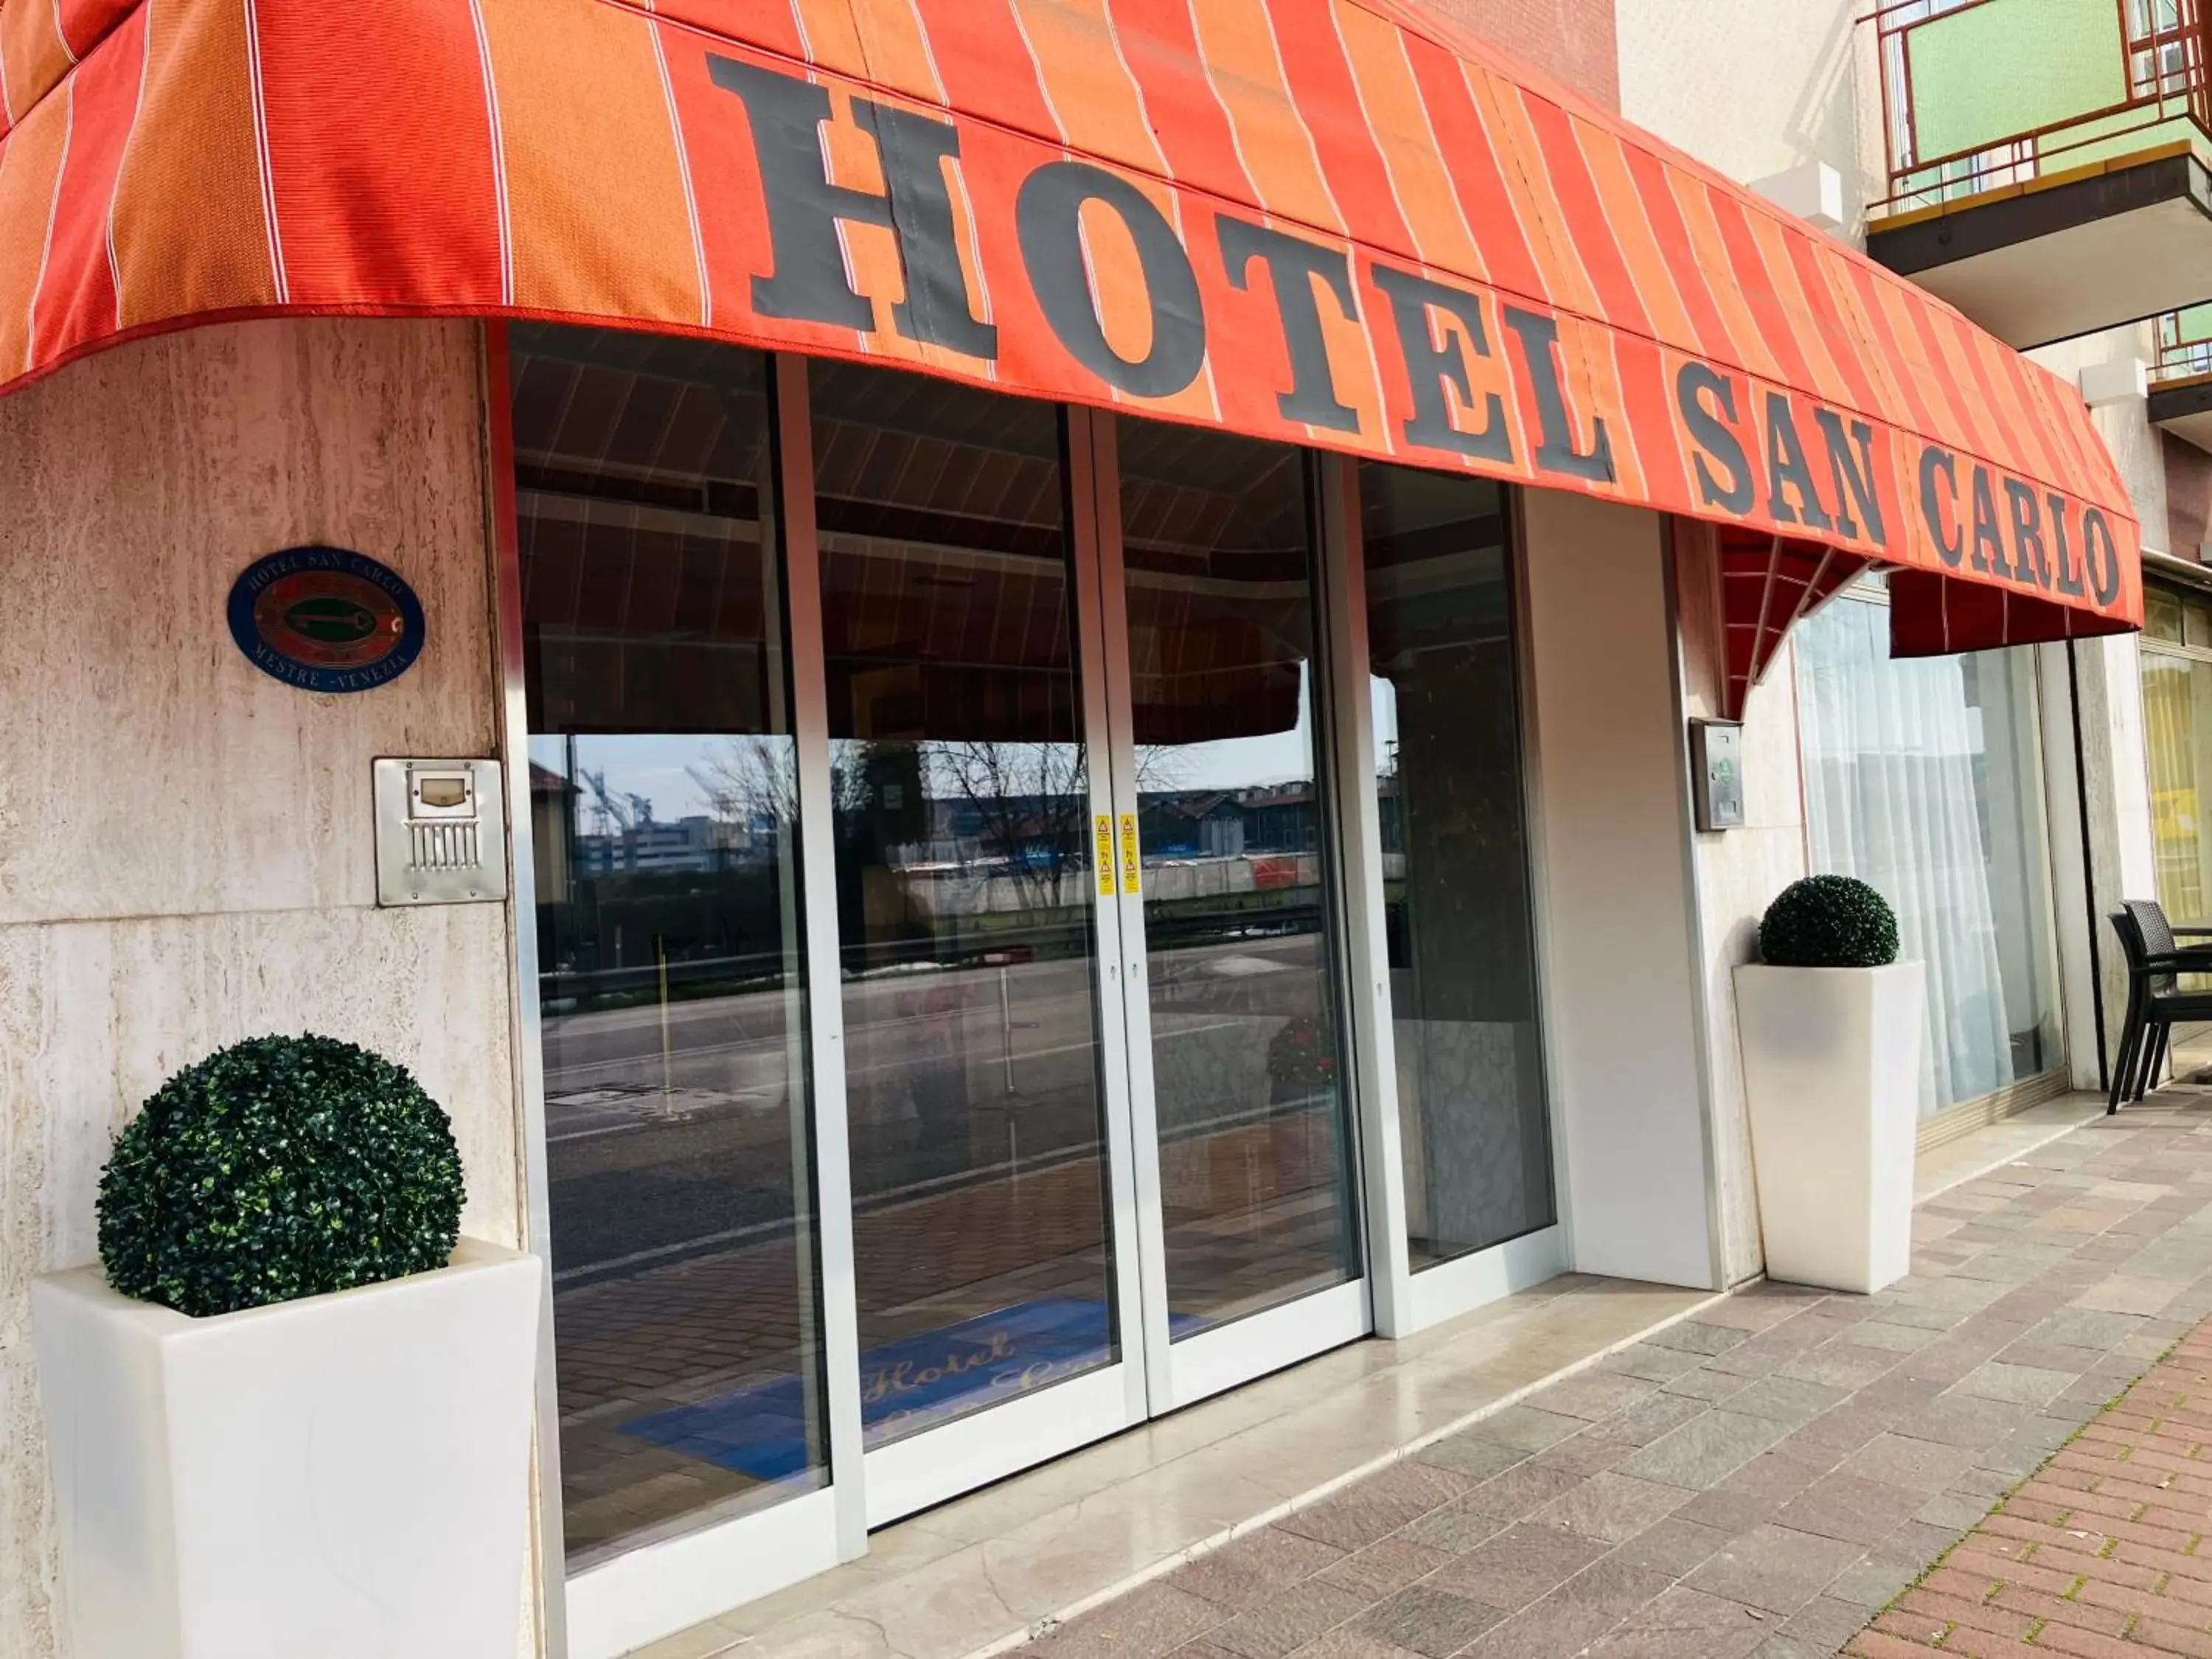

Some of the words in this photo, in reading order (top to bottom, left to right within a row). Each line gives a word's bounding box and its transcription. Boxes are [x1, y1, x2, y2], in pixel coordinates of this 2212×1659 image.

[704, 52, 1617, 484] HOTEL
[1676, 361, 1887, 546] SAN
[1919, 445, 2121, 607] CARLO
[248, 555, 304, 591] HOTEL
[307, 552, 341, 568] SAN
[253, 643, 321, 687] MESTRE
[863, 1331, 1016, 1402] Hotel
